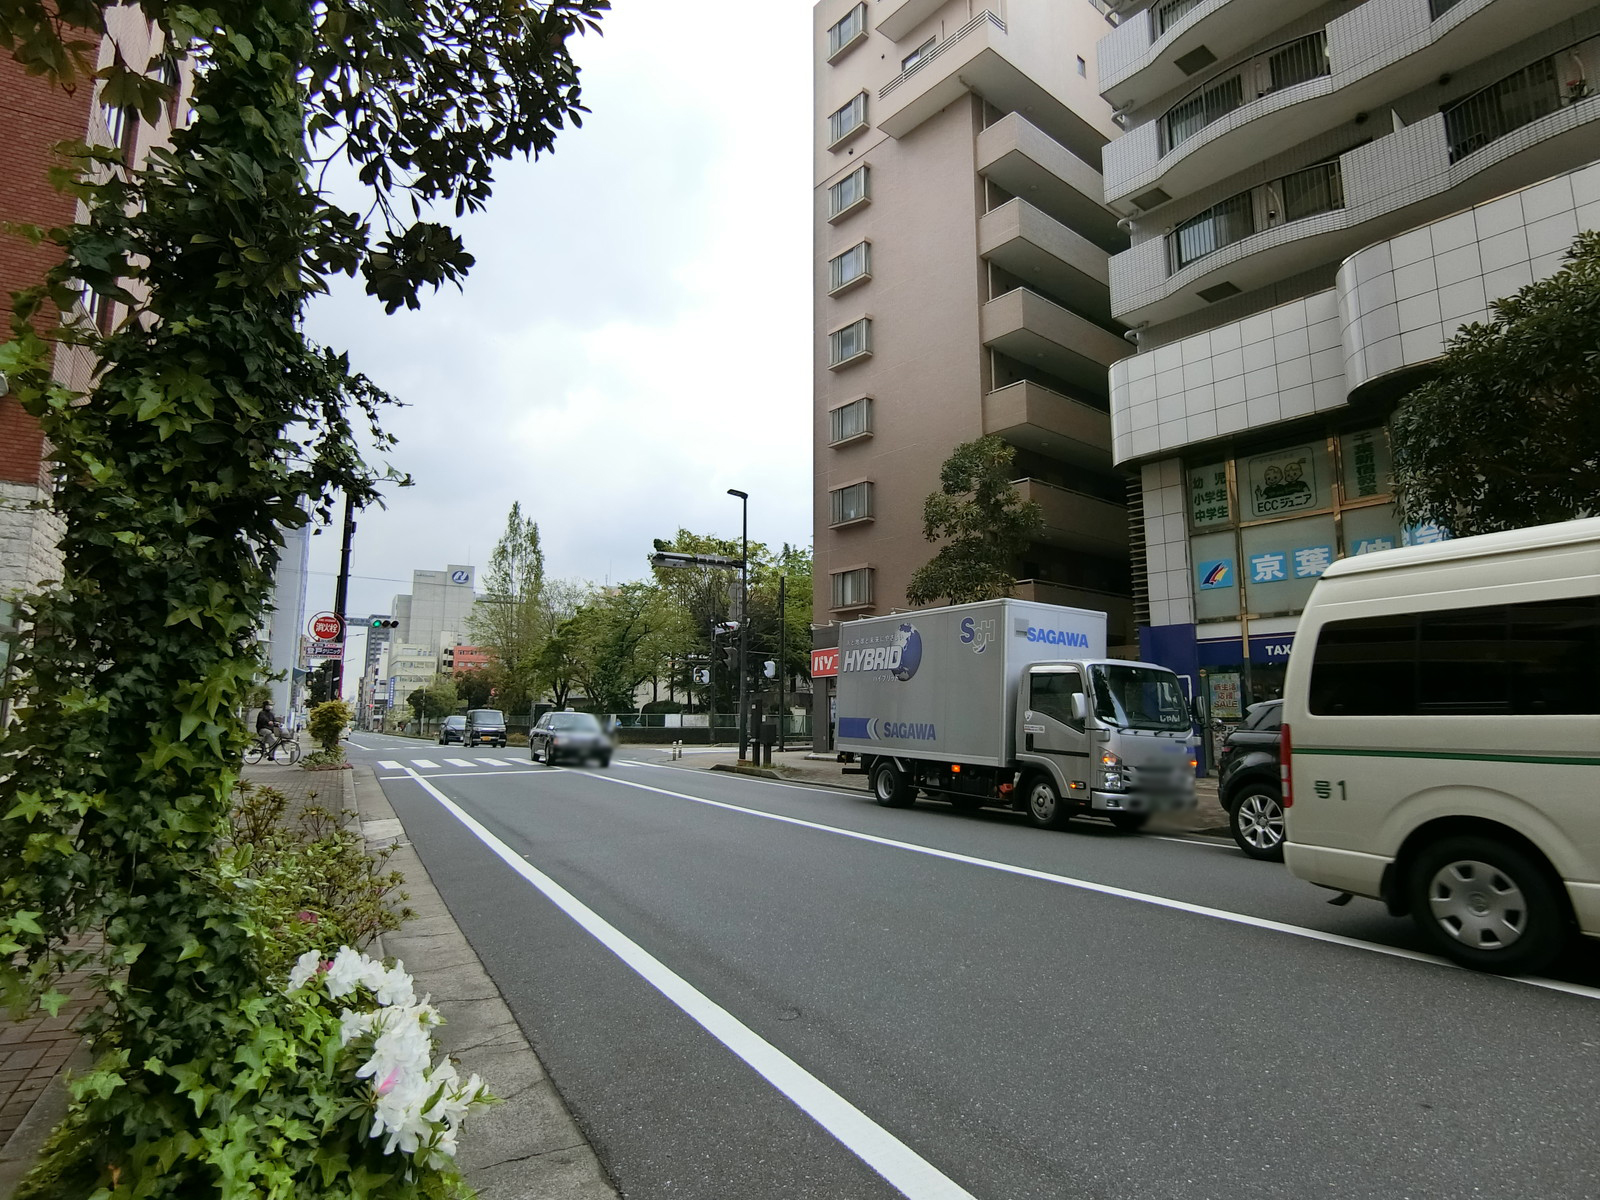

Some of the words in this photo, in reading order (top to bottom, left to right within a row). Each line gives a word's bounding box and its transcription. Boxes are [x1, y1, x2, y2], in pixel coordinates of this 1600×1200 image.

[1194, 489, 1227, 506] 小学生
[1195, 506, 1229, 522] 中学生
[315, 622, 338, 633] 消火栓
[1026, 627, 1089, 648] SAGAWA
[1265, 644, 1291, 656] TAX
[843, 645, 902, 672] HYBRID
[1214, 700, 1238, 708] SALE
[883, 721, 936, 740] SAGAWA
